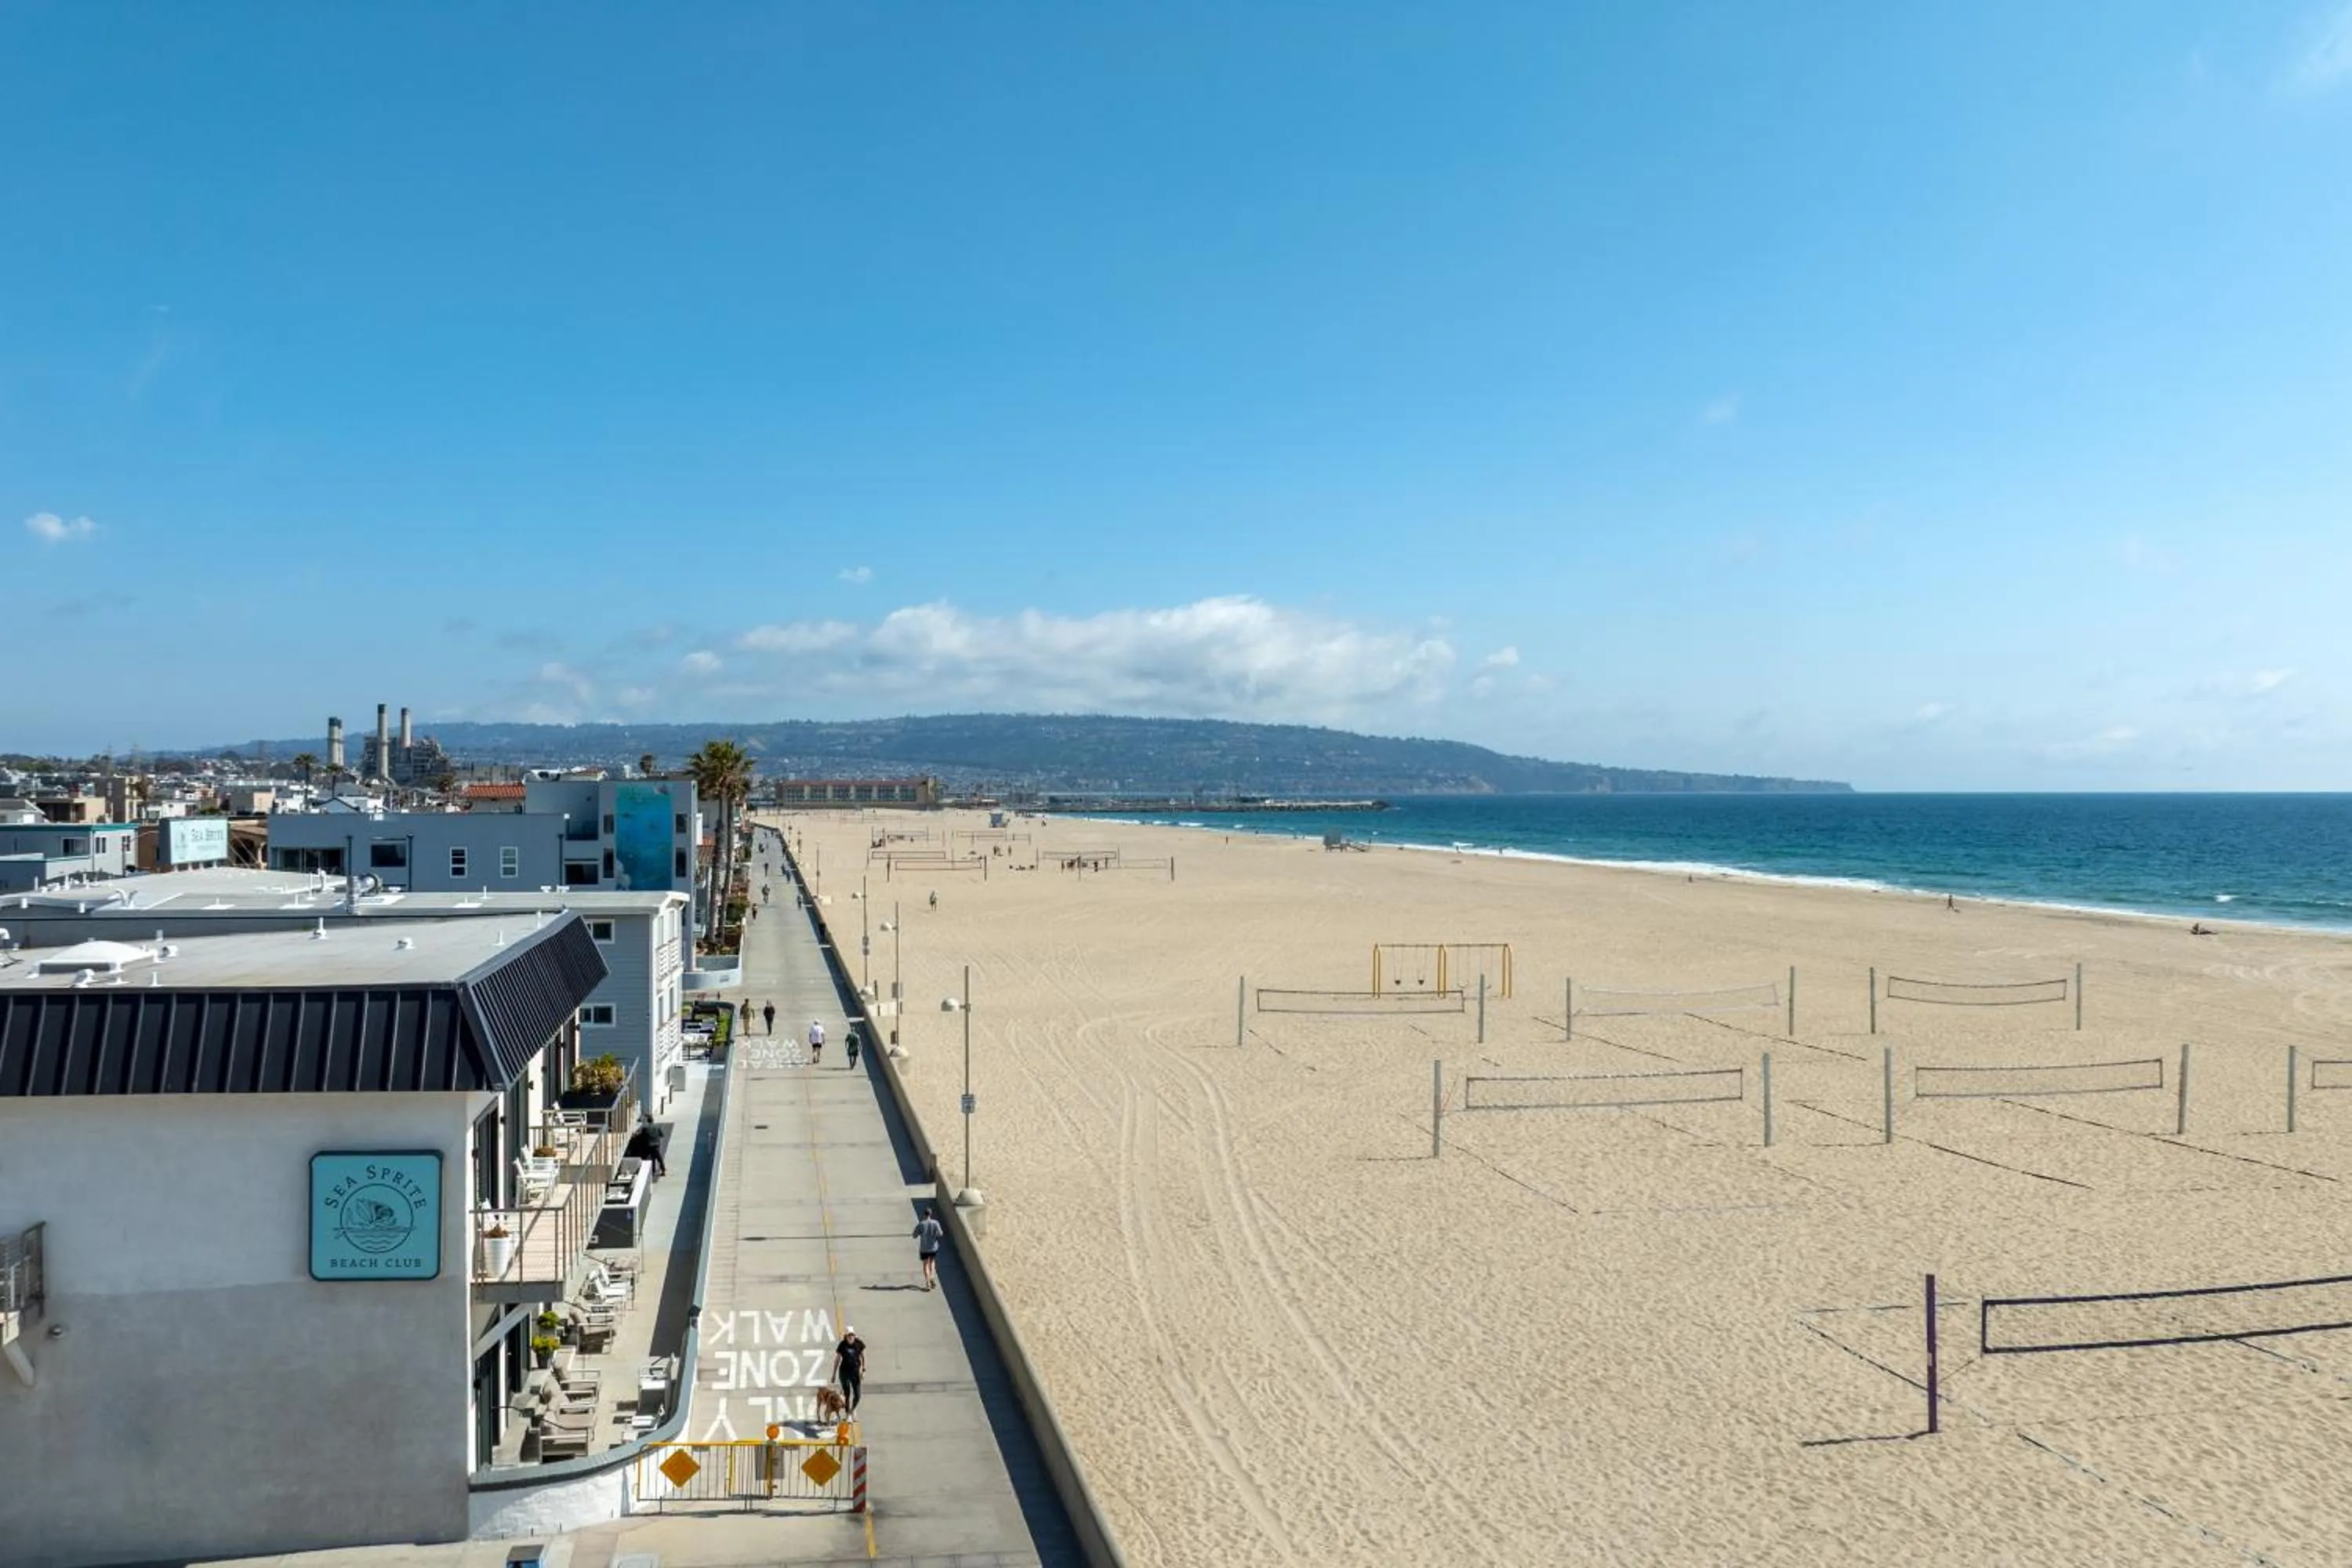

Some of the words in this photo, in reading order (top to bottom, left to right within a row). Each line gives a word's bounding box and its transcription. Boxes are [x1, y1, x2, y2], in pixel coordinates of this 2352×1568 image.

[737, 1039, 800, 1049] WALK
[749, 1048, 802, 1058] ZONE
[324, 1175, 358, 1209] SEA
[366, 1164, 428, 1210] SPRITE
[330, 1258, 378, 1268] BEACH
[385, 1258, 422, 1268] CLUB
[707, 1308, 837, 1345] WALK
[711, 1348, 828, 1391] ZONE
